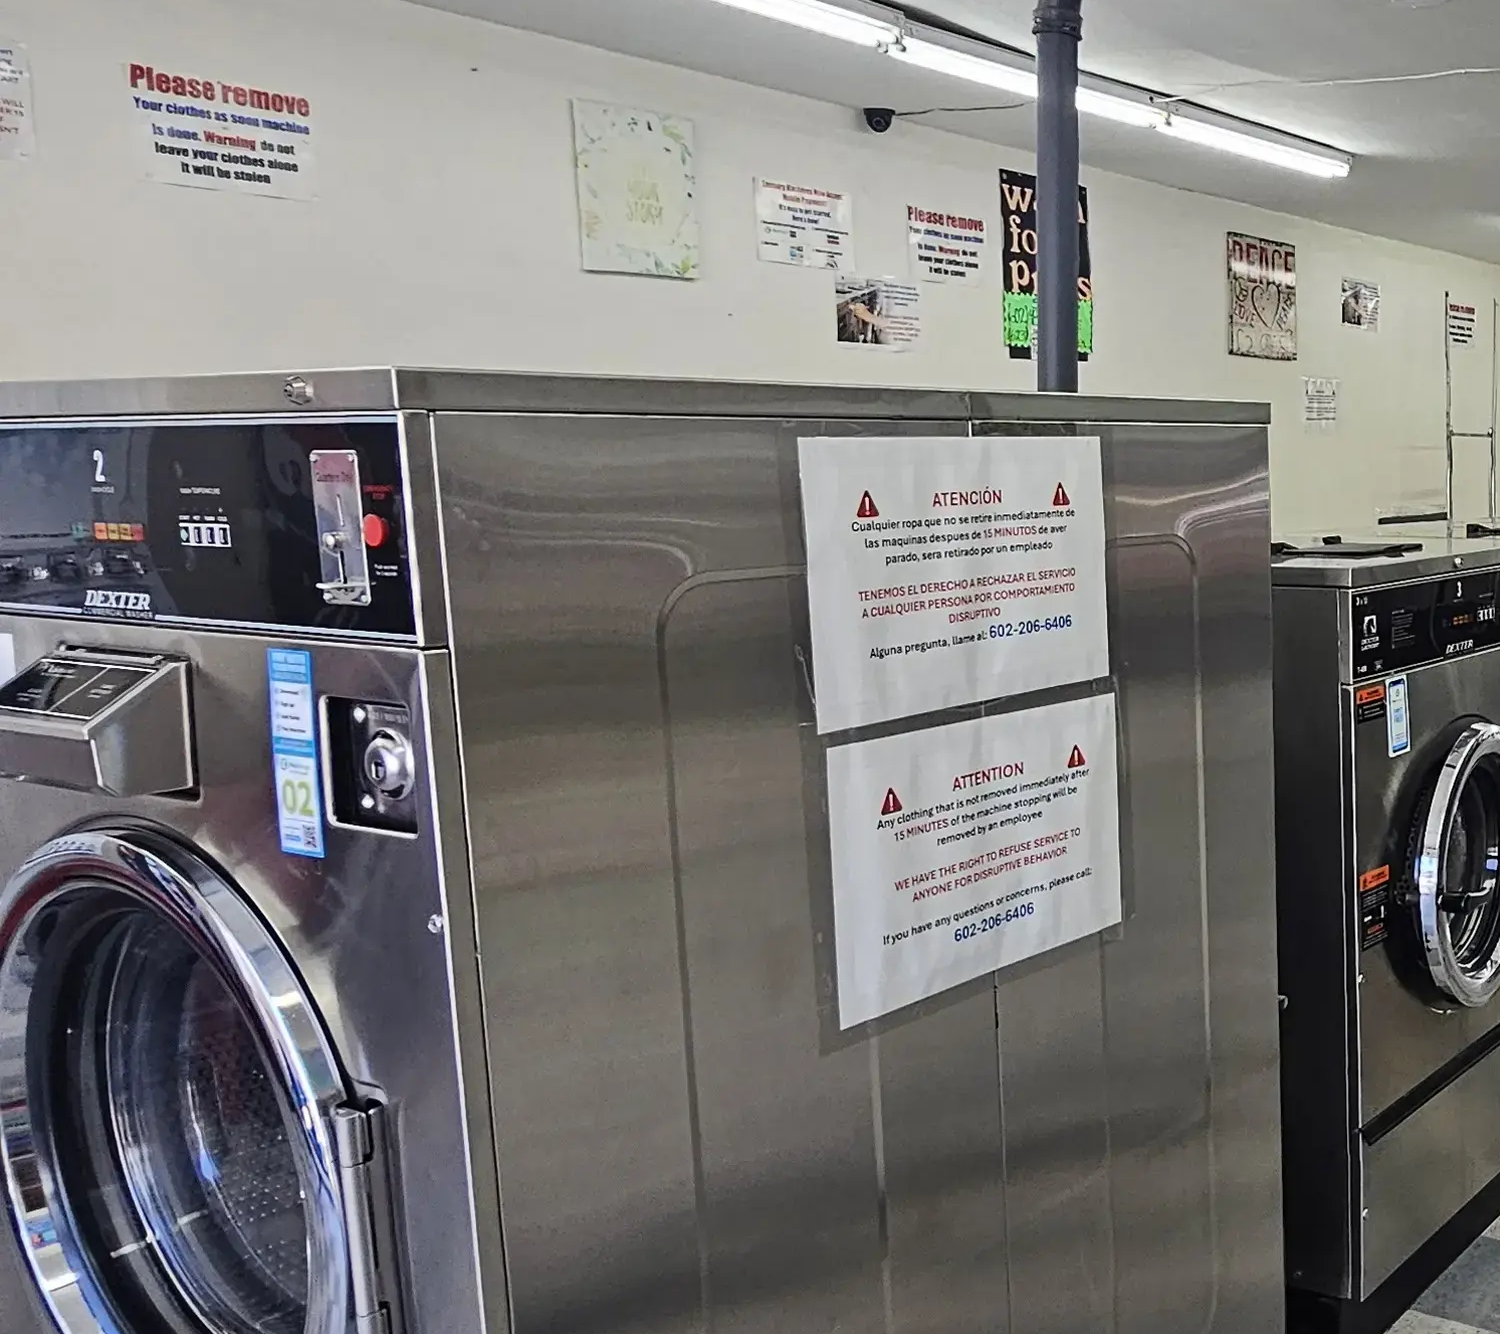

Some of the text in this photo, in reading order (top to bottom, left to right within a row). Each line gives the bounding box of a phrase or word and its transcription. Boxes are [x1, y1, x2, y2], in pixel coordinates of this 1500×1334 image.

[130, 63, 310, 116] Please remove
[133, 96, 309, 135] Your clothes as soon machine
[155, 142, 298, 172] leave your clothes alone
[204, 131, 256, 151] Warning
[261, 140, 274, 152] do
[277, 143, 295, 155] not
[193, 164, 271, 184] will be stolen
[907, 205, 984, 232] Please remove
[93, 449, 106, 482] 2
[932, 485, 1003, 508] ATENCIÓN
[851, 508, 1075, 534] Cualquier ropa que no se retire inmediatamente de
[865, 524, 1068, 549] las maquinas despues de 15 MINUTOS de aver
[885, 540, 1053, 566] parado, sera retirado por un empleado
[84, 590, 151, 610] DEXTER
[859, 568, 1076, 602] TENEMOS EL DERECHO A RECHAZAR EL SERVICIO
[862, 582, 1075, 619] A CUALQUIER PERSONA POR COMPORTAMIENTO
[1456, 580, 1462, 597] 3
[949, 607, 1001, 624] DISRUPTIVO
[870, 645, 902, 659] Alguna
[905, 639, 950, 655] pregunta,
[952, 634, 975, 646] llame
[989, 615, 1072, 639] 602-206-6406
[1445, 640, 1474, 654] DEXTER
[952, 762, 1024, 792] ATTENTION
[282, 781, 315, 817] 02
[877, 768, 1089, 830] Any clothing that is not removed immediately after
[894, 785, 1077, 841] 15 MINUTES of the machine stopping will be
[937, 810, 1043, 846] removed by an employee
[894, 827, 1081, 891] WE HAVE THE RIGHT TO REFUSE SERVICE TO
[912, 846, 1067, 902] ANYONE FOR DISRUPTIVE BEHAVIOR
[883, 934, 890, 945] If
[891, 929, 909, 944] you
[911, 922, 932, 936] have
[935, 915, 951, 929] any
[953, 901, 994, 923] questions
[996, 896, 1005, 906] or
[1006, 885, 1048, 903] concerns,
[954, 902, 1034, 942] 602-206-6406
